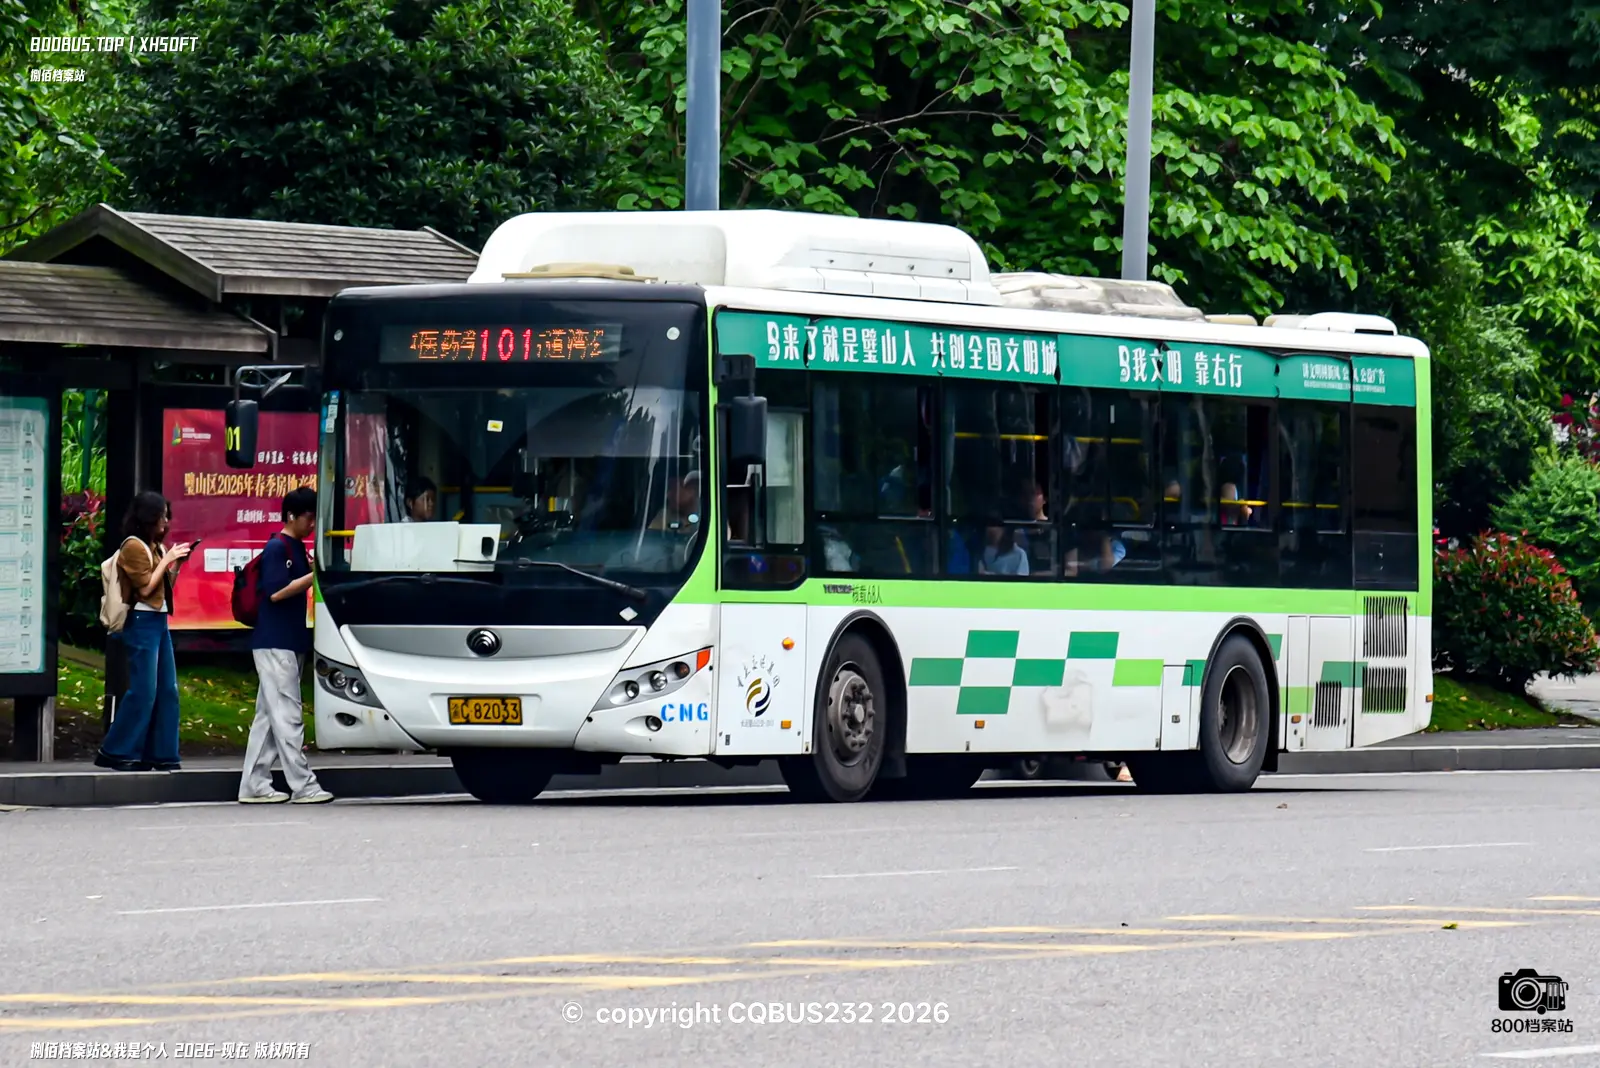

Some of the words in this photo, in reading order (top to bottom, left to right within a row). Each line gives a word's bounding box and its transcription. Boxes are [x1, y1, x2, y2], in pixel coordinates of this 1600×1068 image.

[480, 329, 532, 361] 101
[782, 323, 916, 367] 来了就是璧山人
[930, 331, 1057, 375] 共创全国文明城
[1194, 351, 1243, 388] 靠右行
[225, 426, 240, 451] 01
[660, 702, 709, 722] CNG
